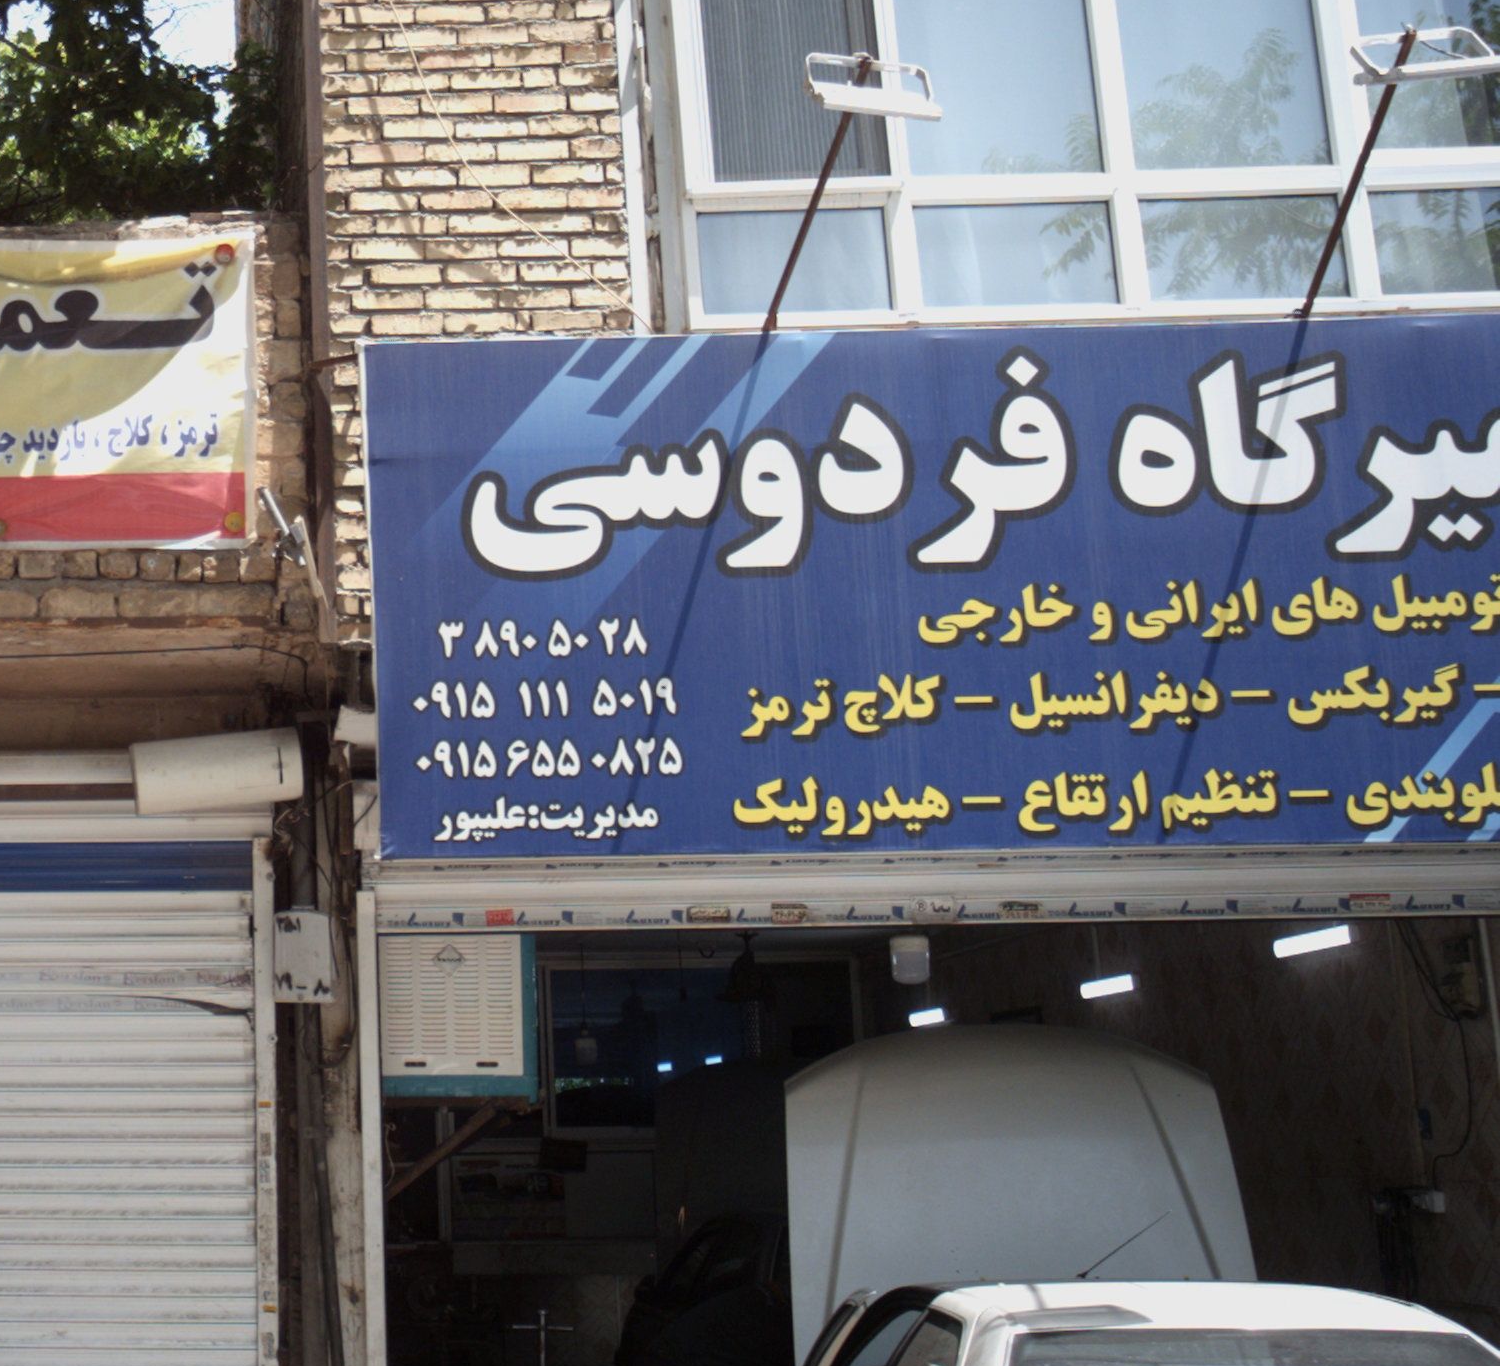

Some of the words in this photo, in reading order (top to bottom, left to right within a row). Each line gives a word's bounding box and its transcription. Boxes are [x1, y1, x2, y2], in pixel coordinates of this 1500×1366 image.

[466, 349, 1072, 577] فردوسی
[916, 583, 1075, 644] خارجی
[1088, 601, 1113, 641] و
[1125, 578, 1258, 640] ایرانی
[1271, 576, 1359, 636] های
[739, 677, 832, 737] ترمز
[843, 673, 941, 733] کلاچ
[1009, 670, 1220, 730] دیفرانسیل
[1287, 662, 1460, 724] گیربکس
[733, 775, 951, 836] هیدرولیک
[1160, 767, 1278, 830] تنظیم
[1345, 761, 1500, 825] لوبندی
